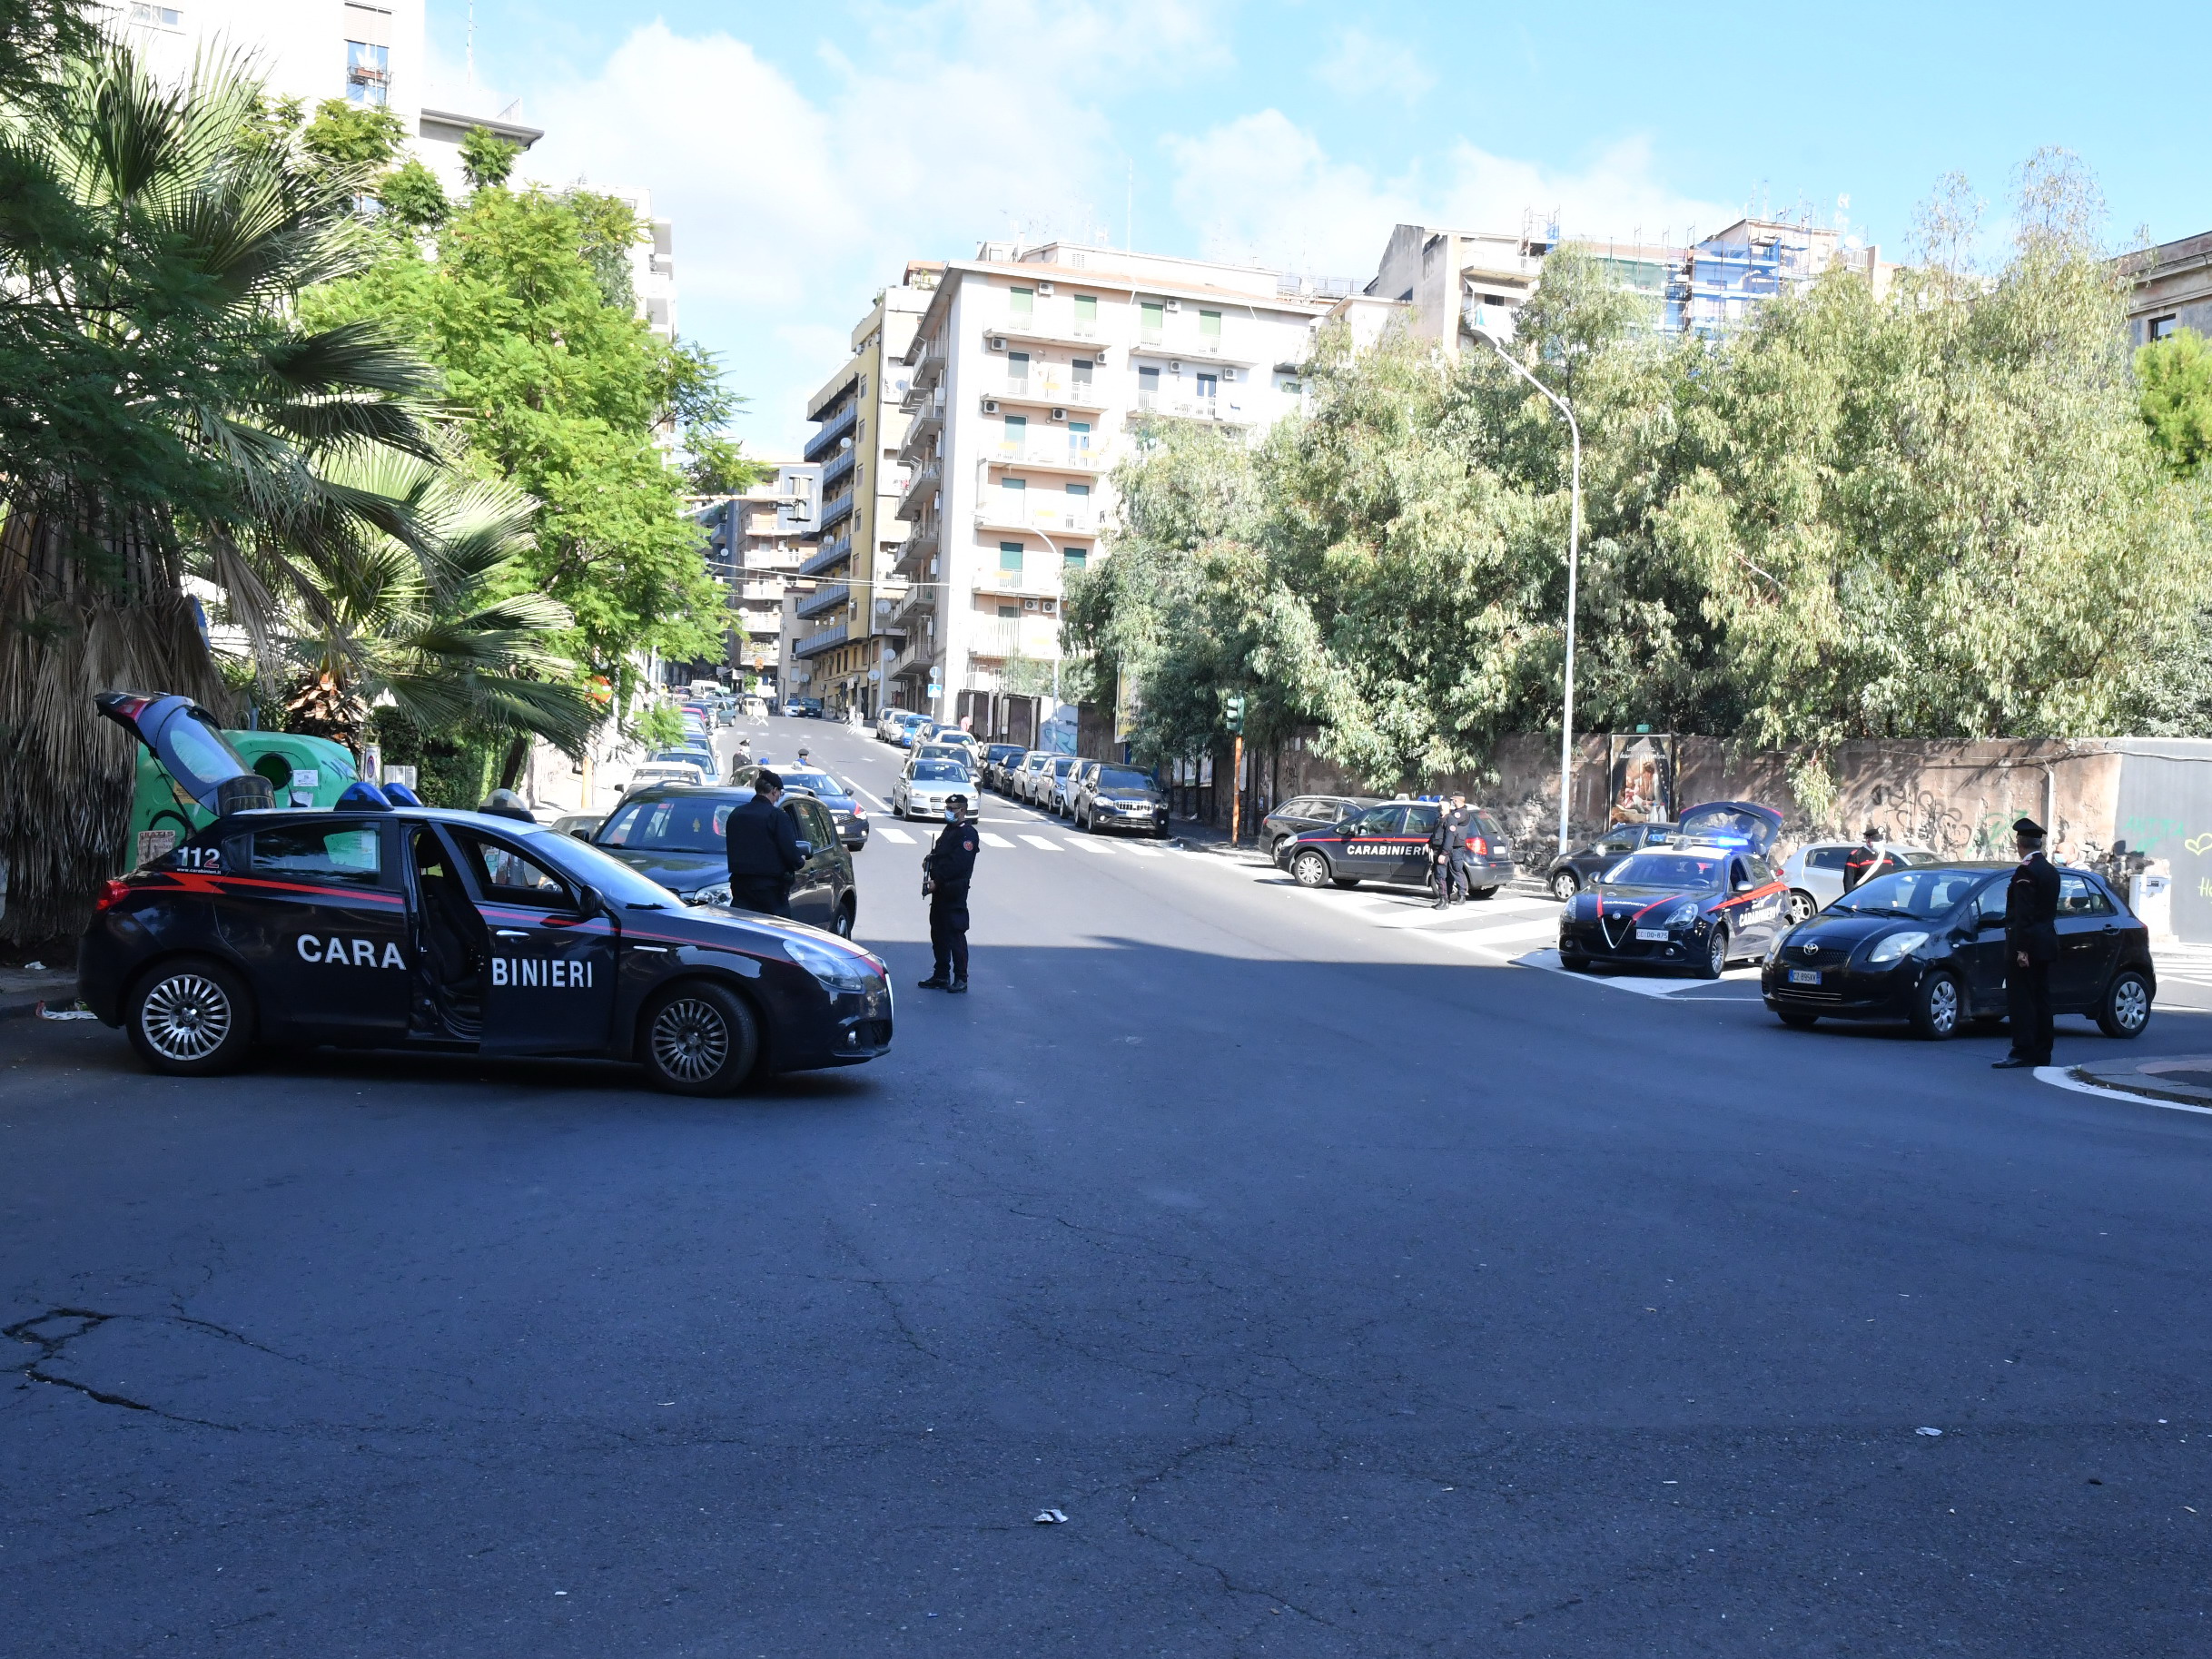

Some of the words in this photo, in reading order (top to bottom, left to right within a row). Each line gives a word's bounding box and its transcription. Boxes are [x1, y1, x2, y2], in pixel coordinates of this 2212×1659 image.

[178, 846, 221, 868] 112
[1347, 845, 1426, 855] CARABINIERI
[297, 934, 407, 970] CARA
[491, 957, 593, 988] BINIERI
